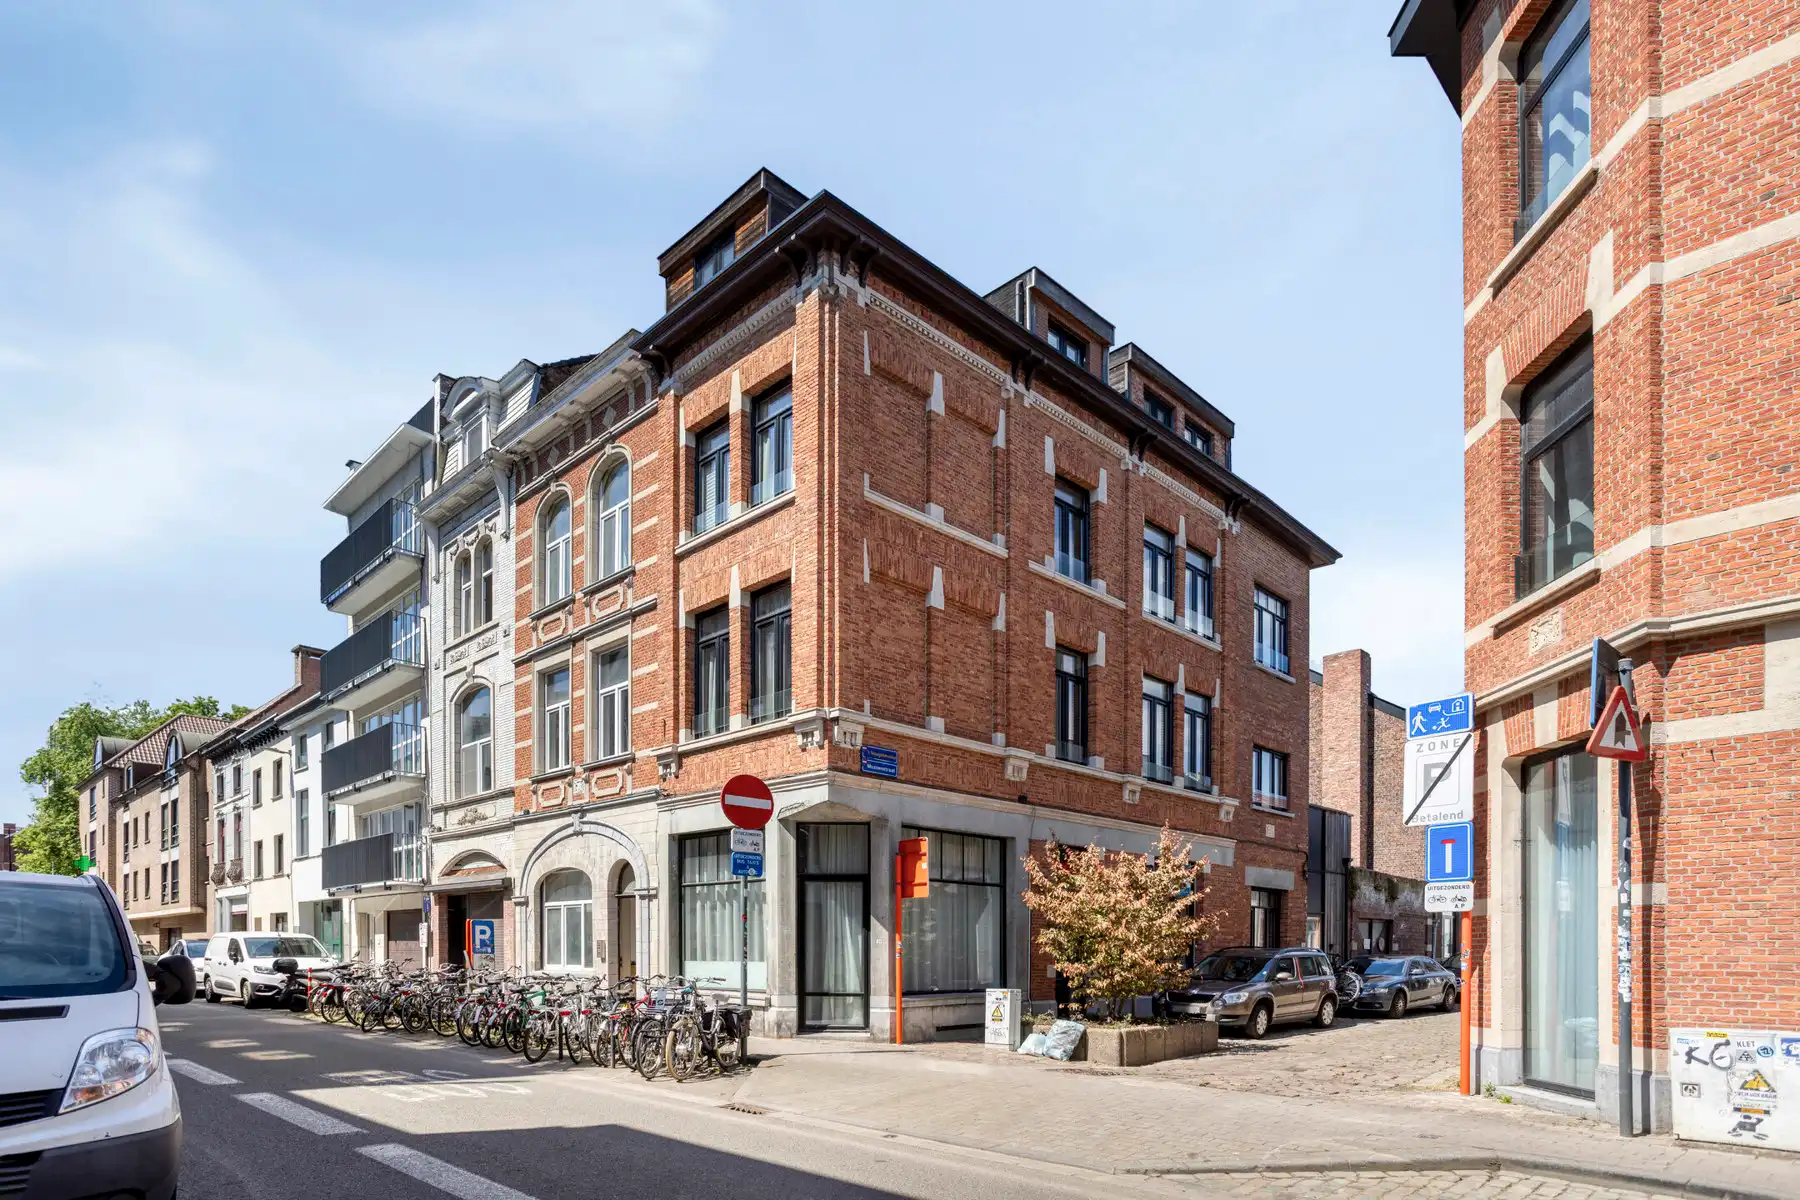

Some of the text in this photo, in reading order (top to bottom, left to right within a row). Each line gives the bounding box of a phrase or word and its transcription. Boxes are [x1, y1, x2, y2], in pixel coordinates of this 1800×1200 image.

[1416, 738, 1461, 753] ZONE
[1423, 761, 1452, 798] P
[1411, 810, 1464, 823] Betalend
[1427, 884, 1471, 892] UITGEZONDERD
[474, 925, 491, 948] P
